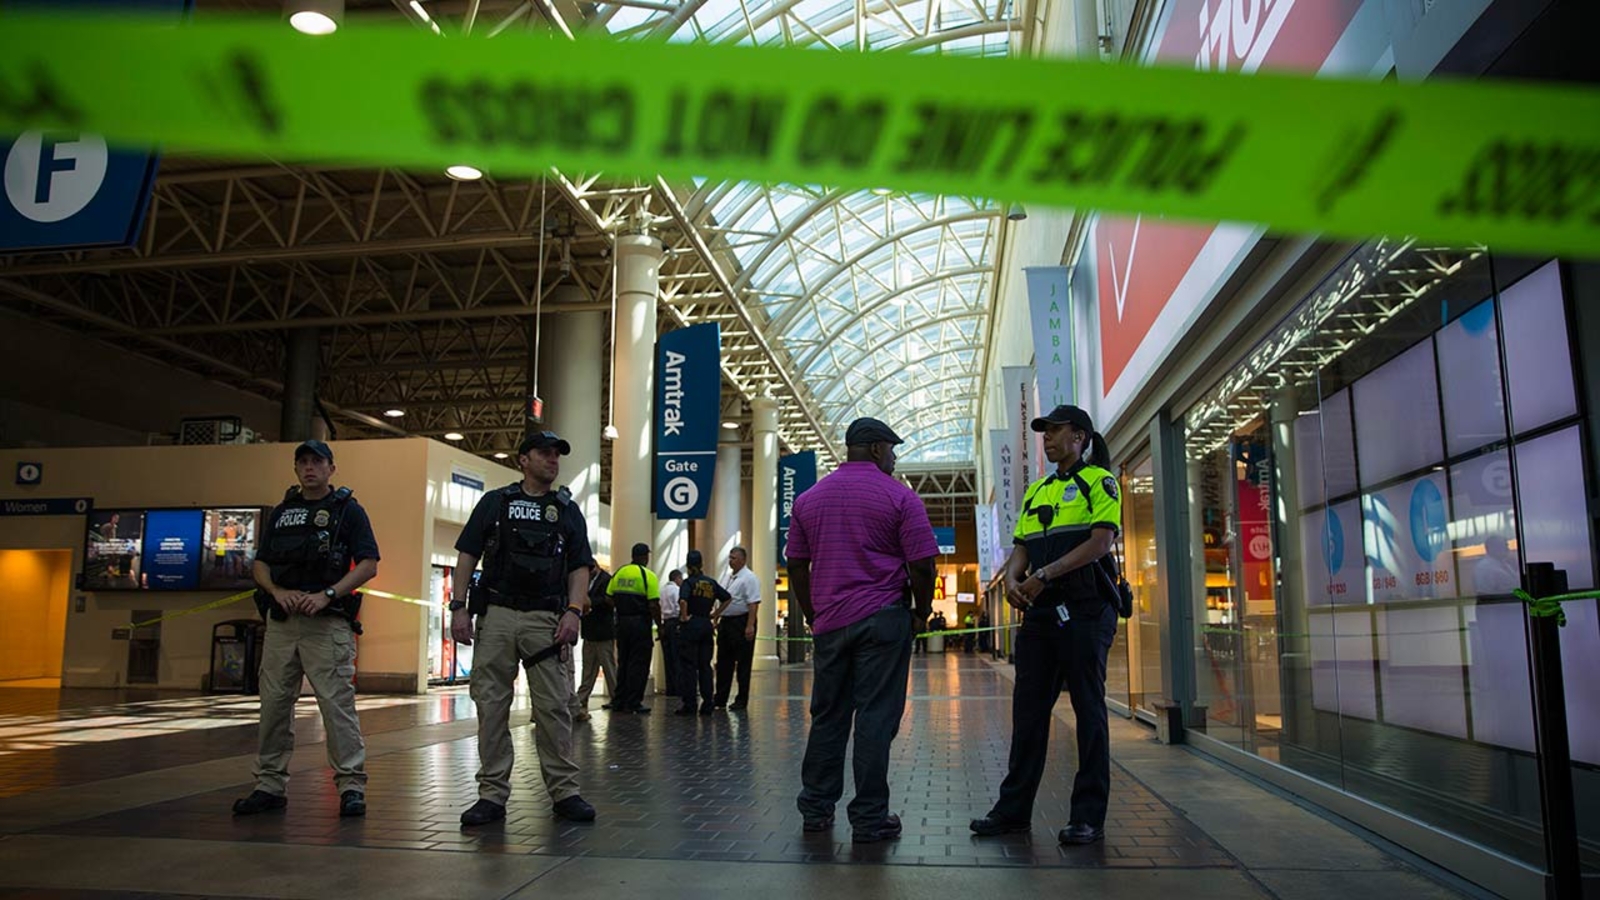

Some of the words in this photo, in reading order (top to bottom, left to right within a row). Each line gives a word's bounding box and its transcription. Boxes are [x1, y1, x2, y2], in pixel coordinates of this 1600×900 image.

[422, 76, 636, 155] CROSS
[661, 92, 783, 168] NOT
[795, 98, 889, 171] DO
[896, 102, 1035, 184] LINE
[34, 131, 81, 205] F
[1033, 113, 1247, 194] POLICE
[1049, 284, 1061, 364] JAMBA
[664, 350, 686, 437] Amtrak
[1053, 377, 1063, 407] JU
[665, 459, 698, 473] Gate
[670, 483, 689, 505] G
[783, 466, 796, 519] Amtrak
[4, 500, 48, 513] Women
[279, 513, 308, 528] POLICE
[508, 506, 541, 521] POLICE
[981, 512, 989, 572] KASHMIR
